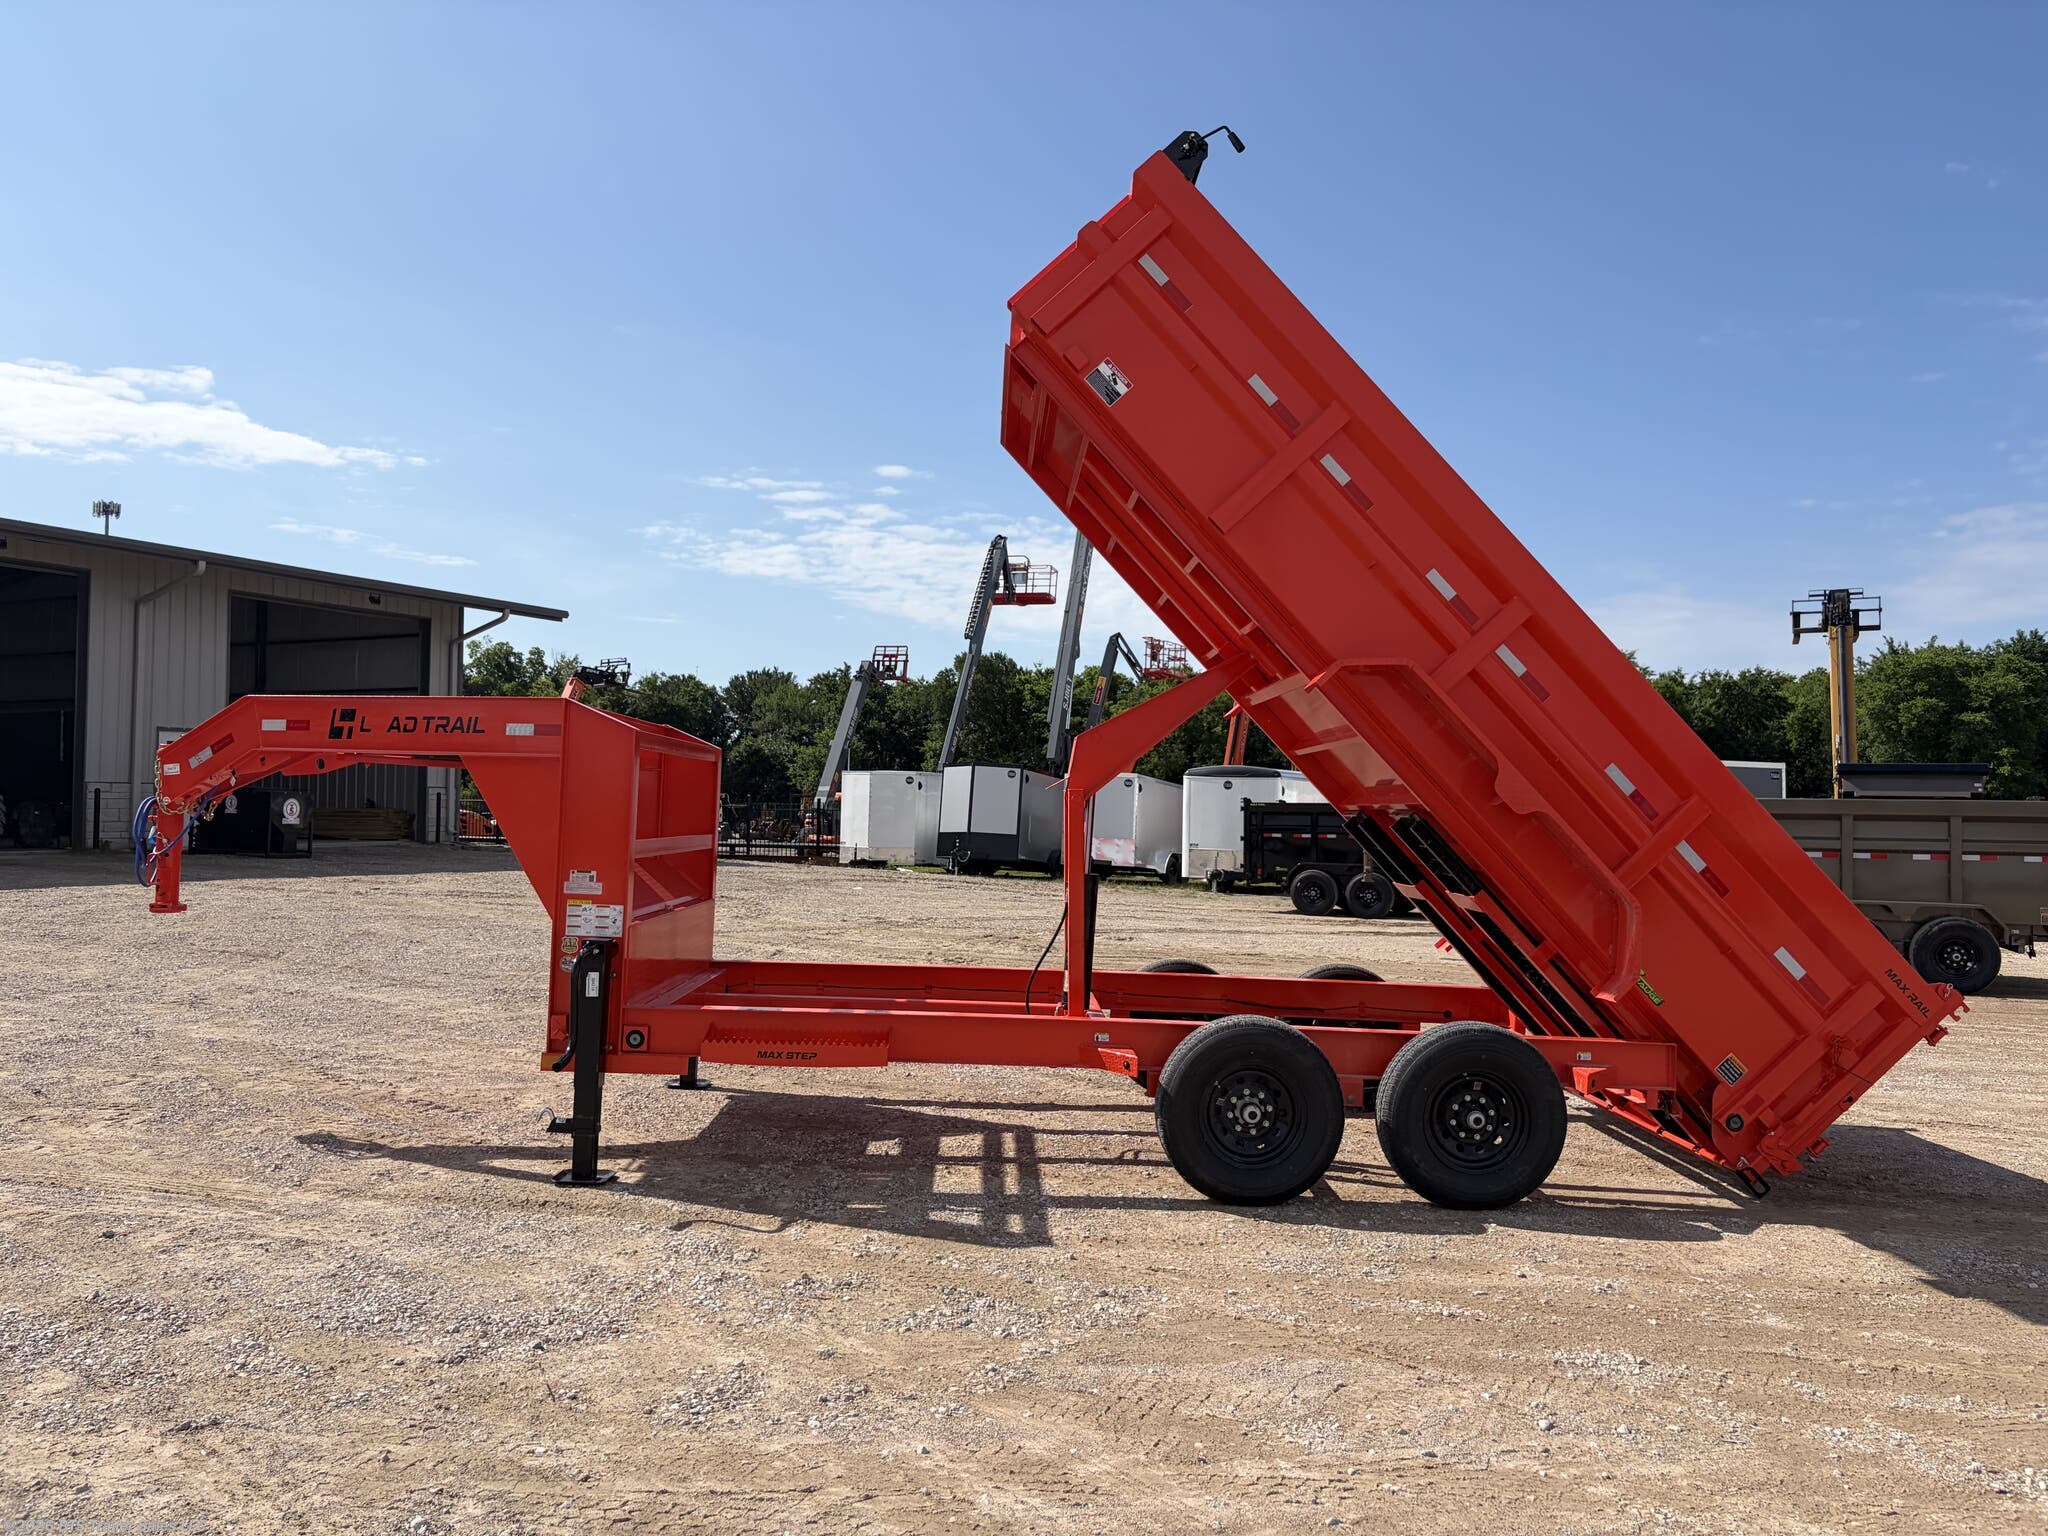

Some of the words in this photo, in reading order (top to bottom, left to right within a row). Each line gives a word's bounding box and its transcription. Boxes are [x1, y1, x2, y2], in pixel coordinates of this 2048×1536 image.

[422, 716, 485, 734] TRAIL
[1884, 968, 1910, 994] MAX
[1907, 993, 1931, 1019] RAIL
[757, 1051, 783, 1060] MAX
[786, 1051, 817, 1061] STEP
